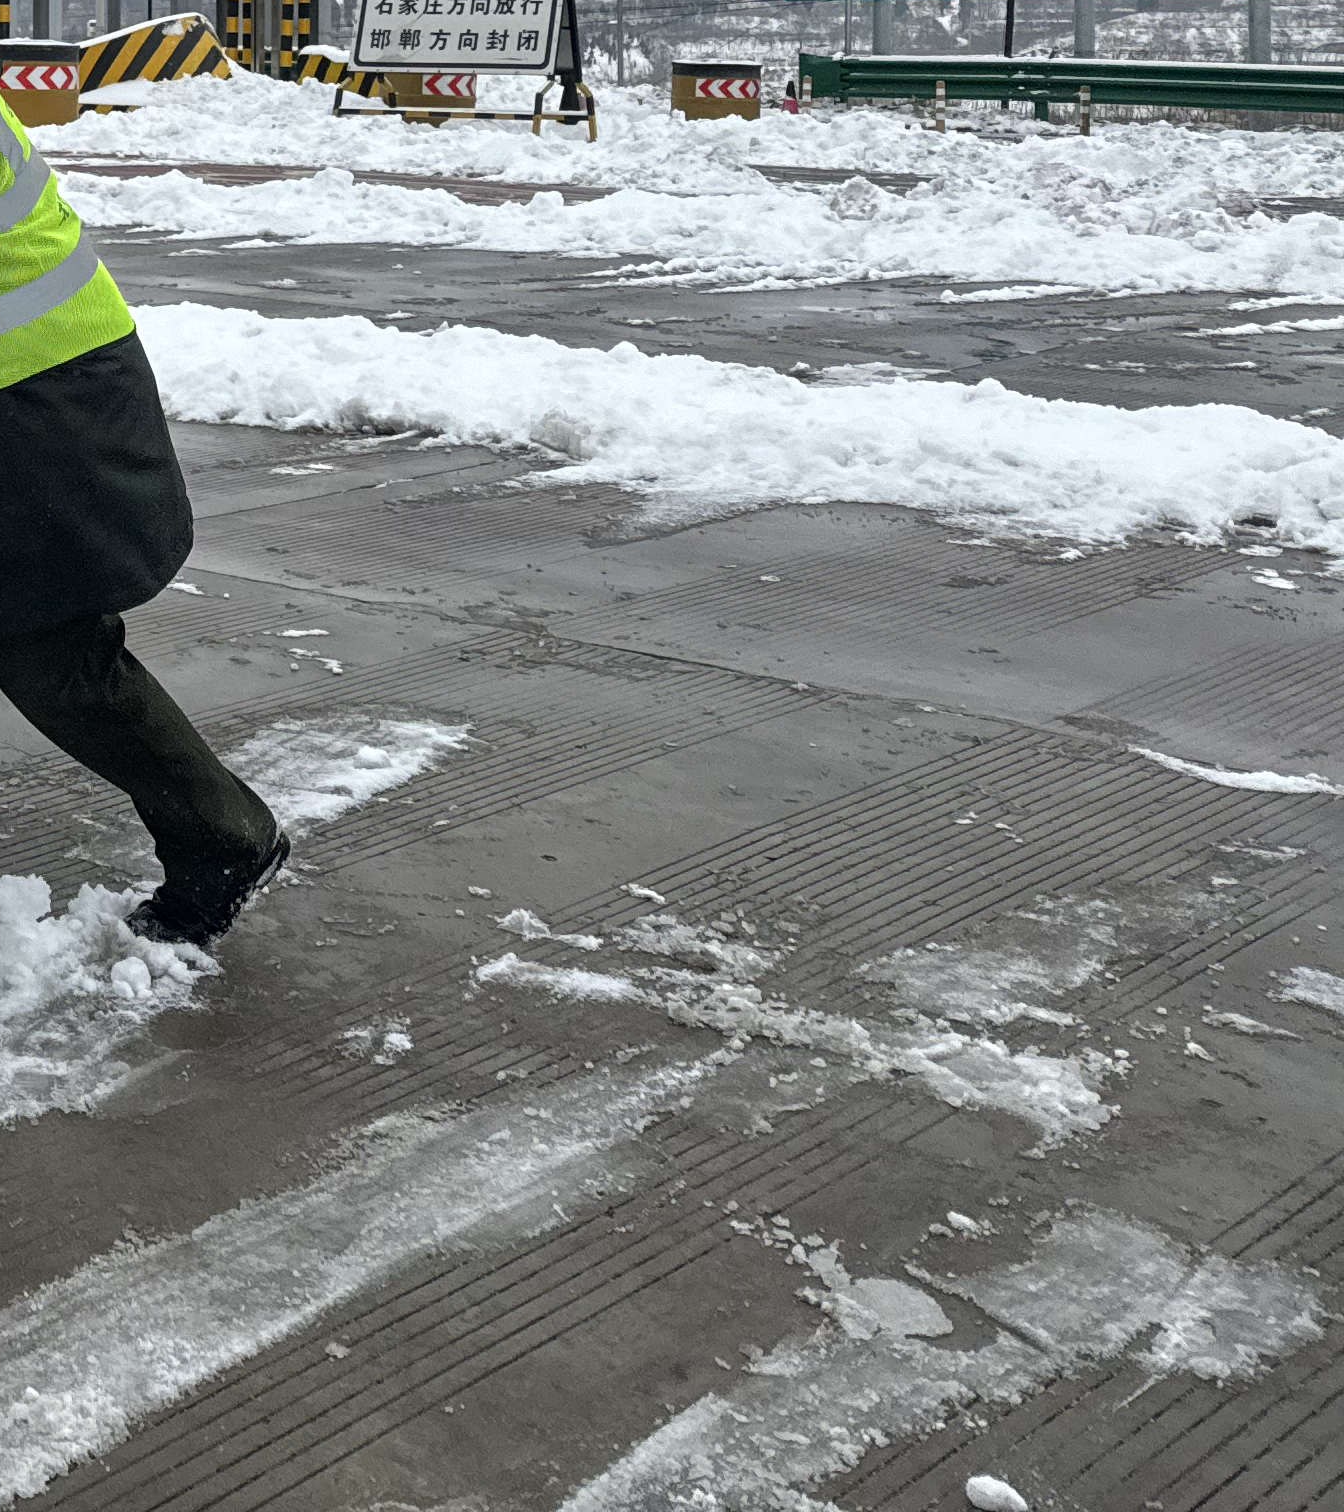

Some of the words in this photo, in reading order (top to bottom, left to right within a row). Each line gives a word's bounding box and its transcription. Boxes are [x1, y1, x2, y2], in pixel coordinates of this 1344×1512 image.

[370, 29, 540, 52] 邯郸方向封闭
